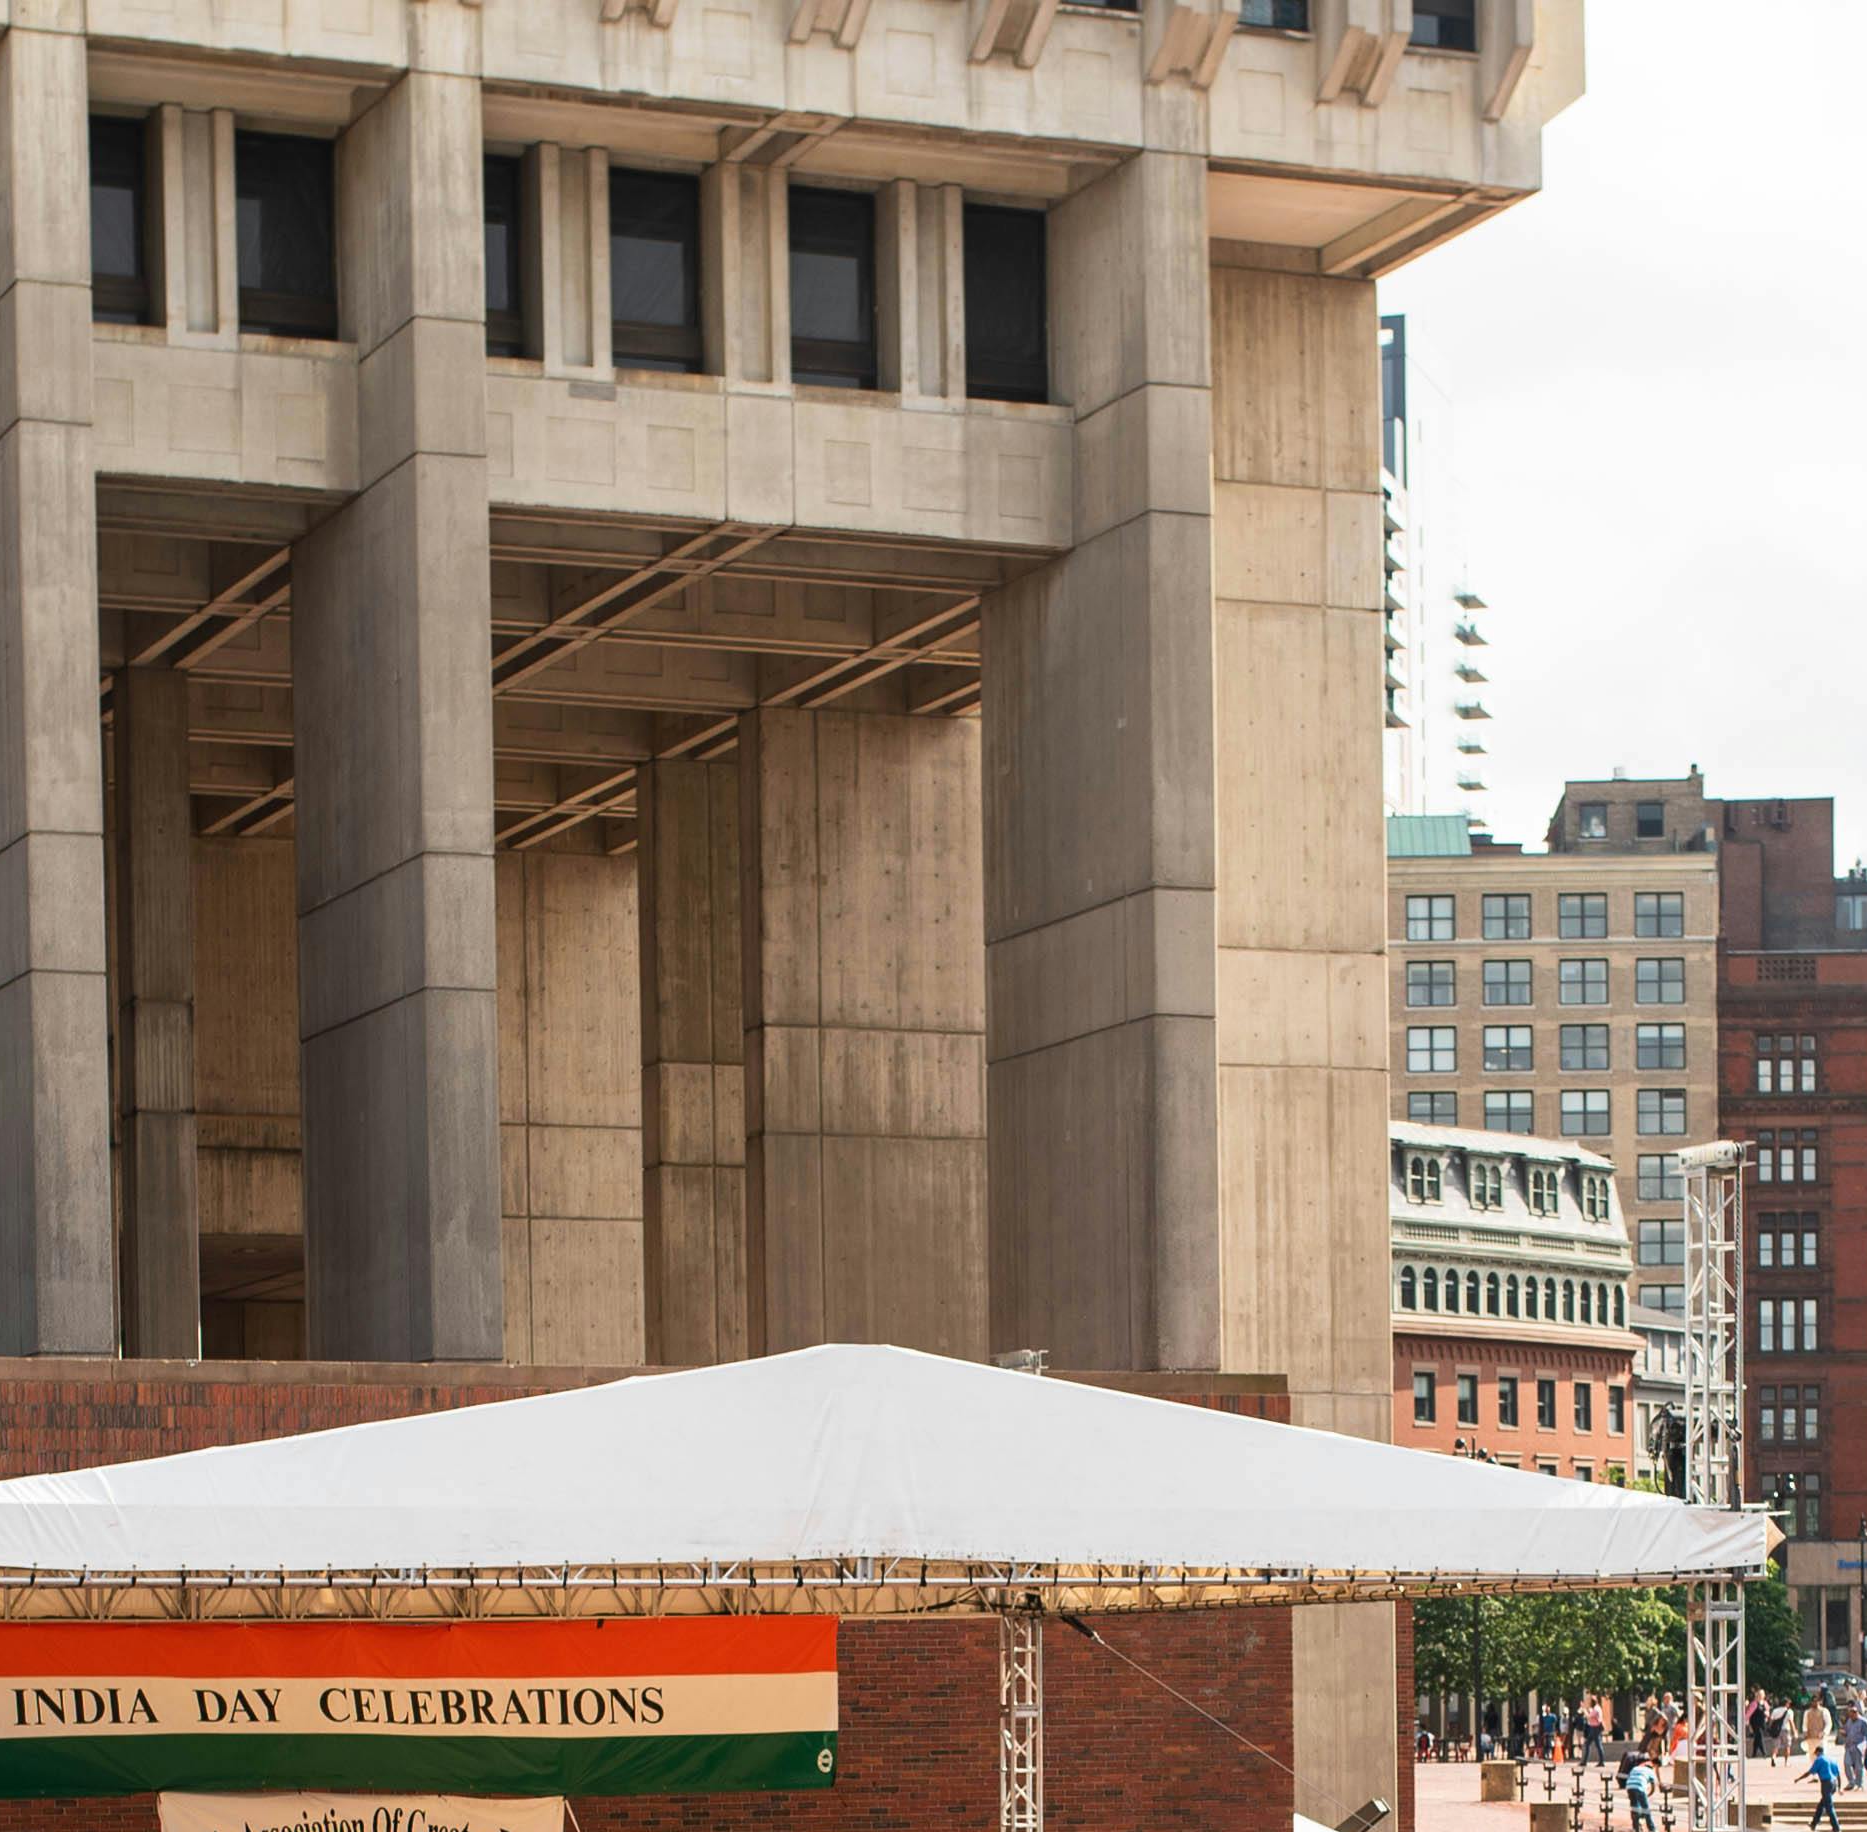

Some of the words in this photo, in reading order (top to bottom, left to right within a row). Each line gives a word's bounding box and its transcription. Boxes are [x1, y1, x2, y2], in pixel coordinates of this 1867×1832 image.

[11, 1688, 159, 1725] INDIA
[193, 1688, 282, 1723] DAY
[318, 1687, 665, 1726] CELEBRATIONS
